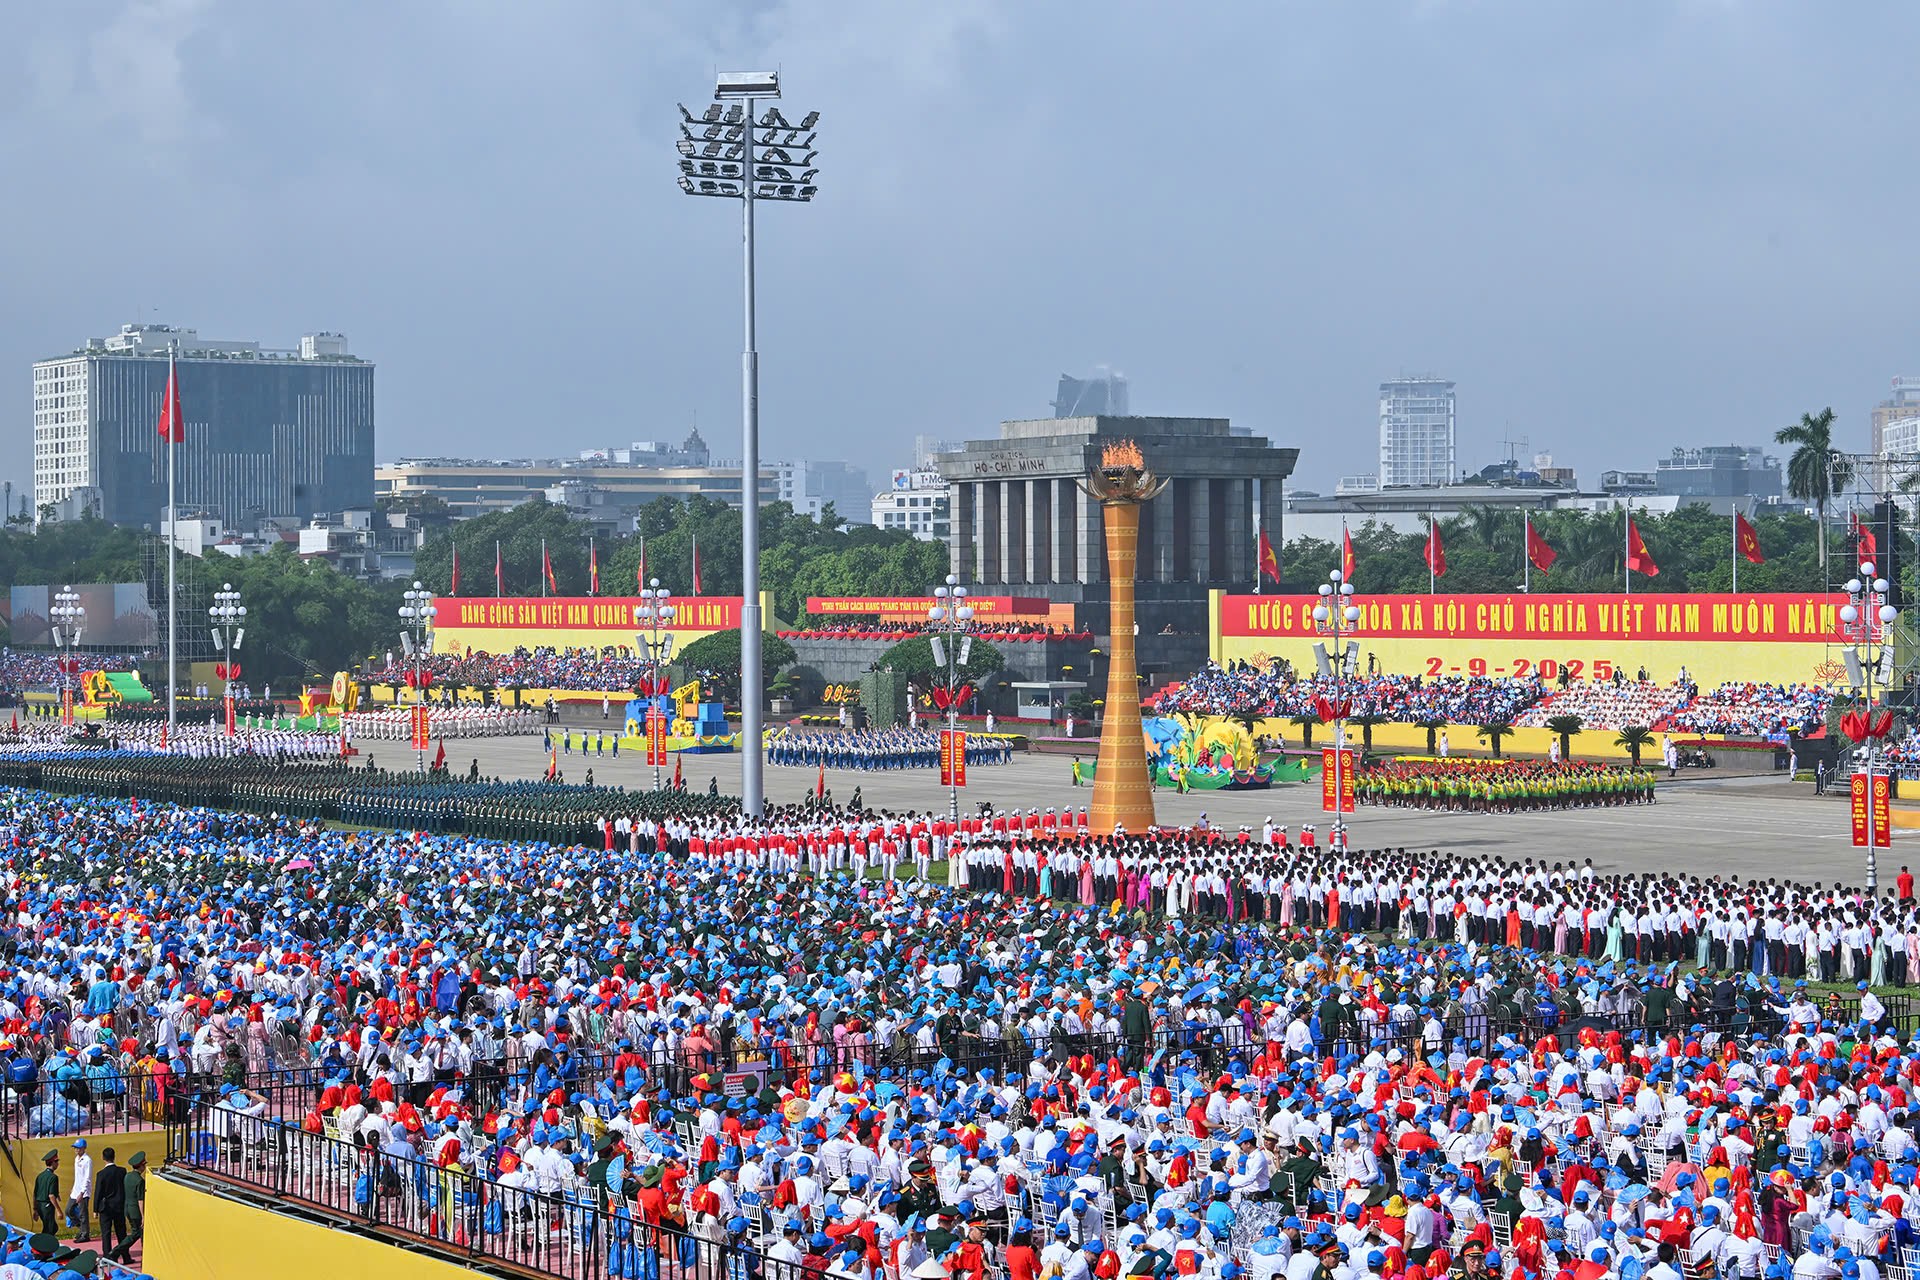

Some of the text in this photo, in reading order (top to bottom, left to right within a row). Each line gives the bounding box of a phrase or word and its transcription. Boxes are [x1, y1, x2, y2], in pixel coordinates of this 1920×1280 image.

[461, 600, 486, 624] ĐẢNG
[489, 601, 515, 628] CỘNG
[518, 600, 537, 625] SẢN
[541, 601, 563, 628] VIỆT
[567, 604, 589, 625] NAM
[593, 604, 628, 627] QUANG
[698, 601, 721, 626] NĂM
[1248, 599, 1293, 631] NƯỚC
[1357, 599, 1393, 631] HÒA
[1401, 599, 1424, 631] XÃ
[1433, 599, 1466, 636] HỘI
[1476, 597, 1514, 632] CHỦ
[1525, 599, 1588, 633] NGHĨA
[1597, 599, 1644, 638] VIỆT
[1655, 603, 1700, 633] NAM
[1712, 598, 1775, 634] MUÔN
[1787, 598, 1836, 635] NĂM
